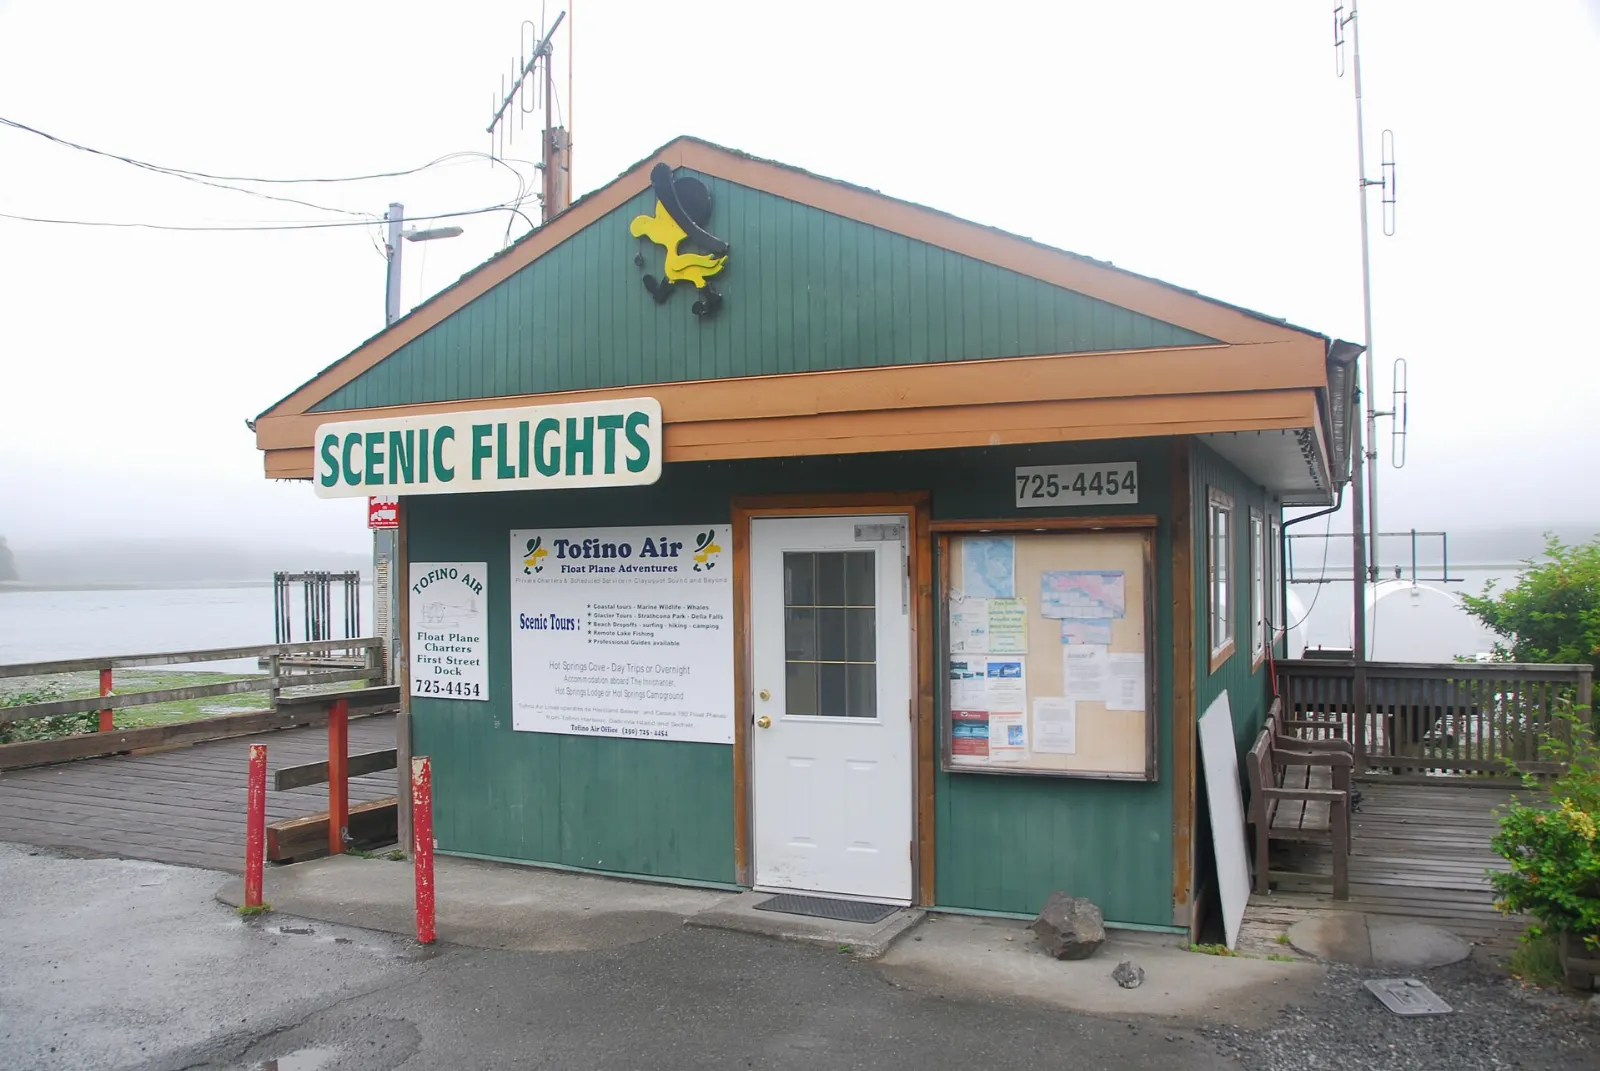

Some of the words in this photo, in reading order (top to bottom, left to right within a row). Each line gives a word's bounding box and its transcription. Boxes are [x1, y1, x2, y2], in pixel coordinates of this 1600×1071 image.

[320, 425, 455, 488] SCENIC
[471, 411, 651, 480] FLIGHTS
[1017, 470, 1136, 499] 725-4454
[553, 538, 632, 559] Tofino
[639, 536, 683, 558] Air
[561, 564, 586, 574] Float
[588, 564, 616, 574] Plane
[618, 564, 678, 573] Adventures
[412, 568, 458, 595] TOFINO
[461, 573, 483, 595] AIR
[703, 577, 728, 585] Beyond
[520, 613, 548, 630] Scenic
[643, 622, 663, 630] surfing
[668, 622, 687, 630] hiking
[692, 623, 719, 631] camping
[417, 632, 444, 642] Float
[449, 633, 480, 643] Plane
[424, 643, 472, 653] Charters
[417, 654, 441, 664] First
[446, 656, 480, 666] Street
[434, 666, 462, 676] Dock
[549, 661, 561, 670] Hot
[562, 661, 587, 673] Springs
[588, 662, 605, 672] Cove
[611, 662, 625, 675] Day
[626, 663, 644, 675] Trips
[645, 665, 653, 674] or
[655, 664, 690, 677] Overnight
[630, 677, 642, 686] The
[416, 679, 480, 697] 725-4454
[555, 687, 565, 695] Hot
[566, 687, 587, 698] Springs
[587, 688, 604, 698] Lodge
[612, 689, 622, 698] Hot
[624, 689, 645, 700] Springs
[646, 690, 684, 701] Campground
[571, 724, 589, 732] Tofino
[590, 725, 600, 733] Air
[601, 726, 618, 734] Office
